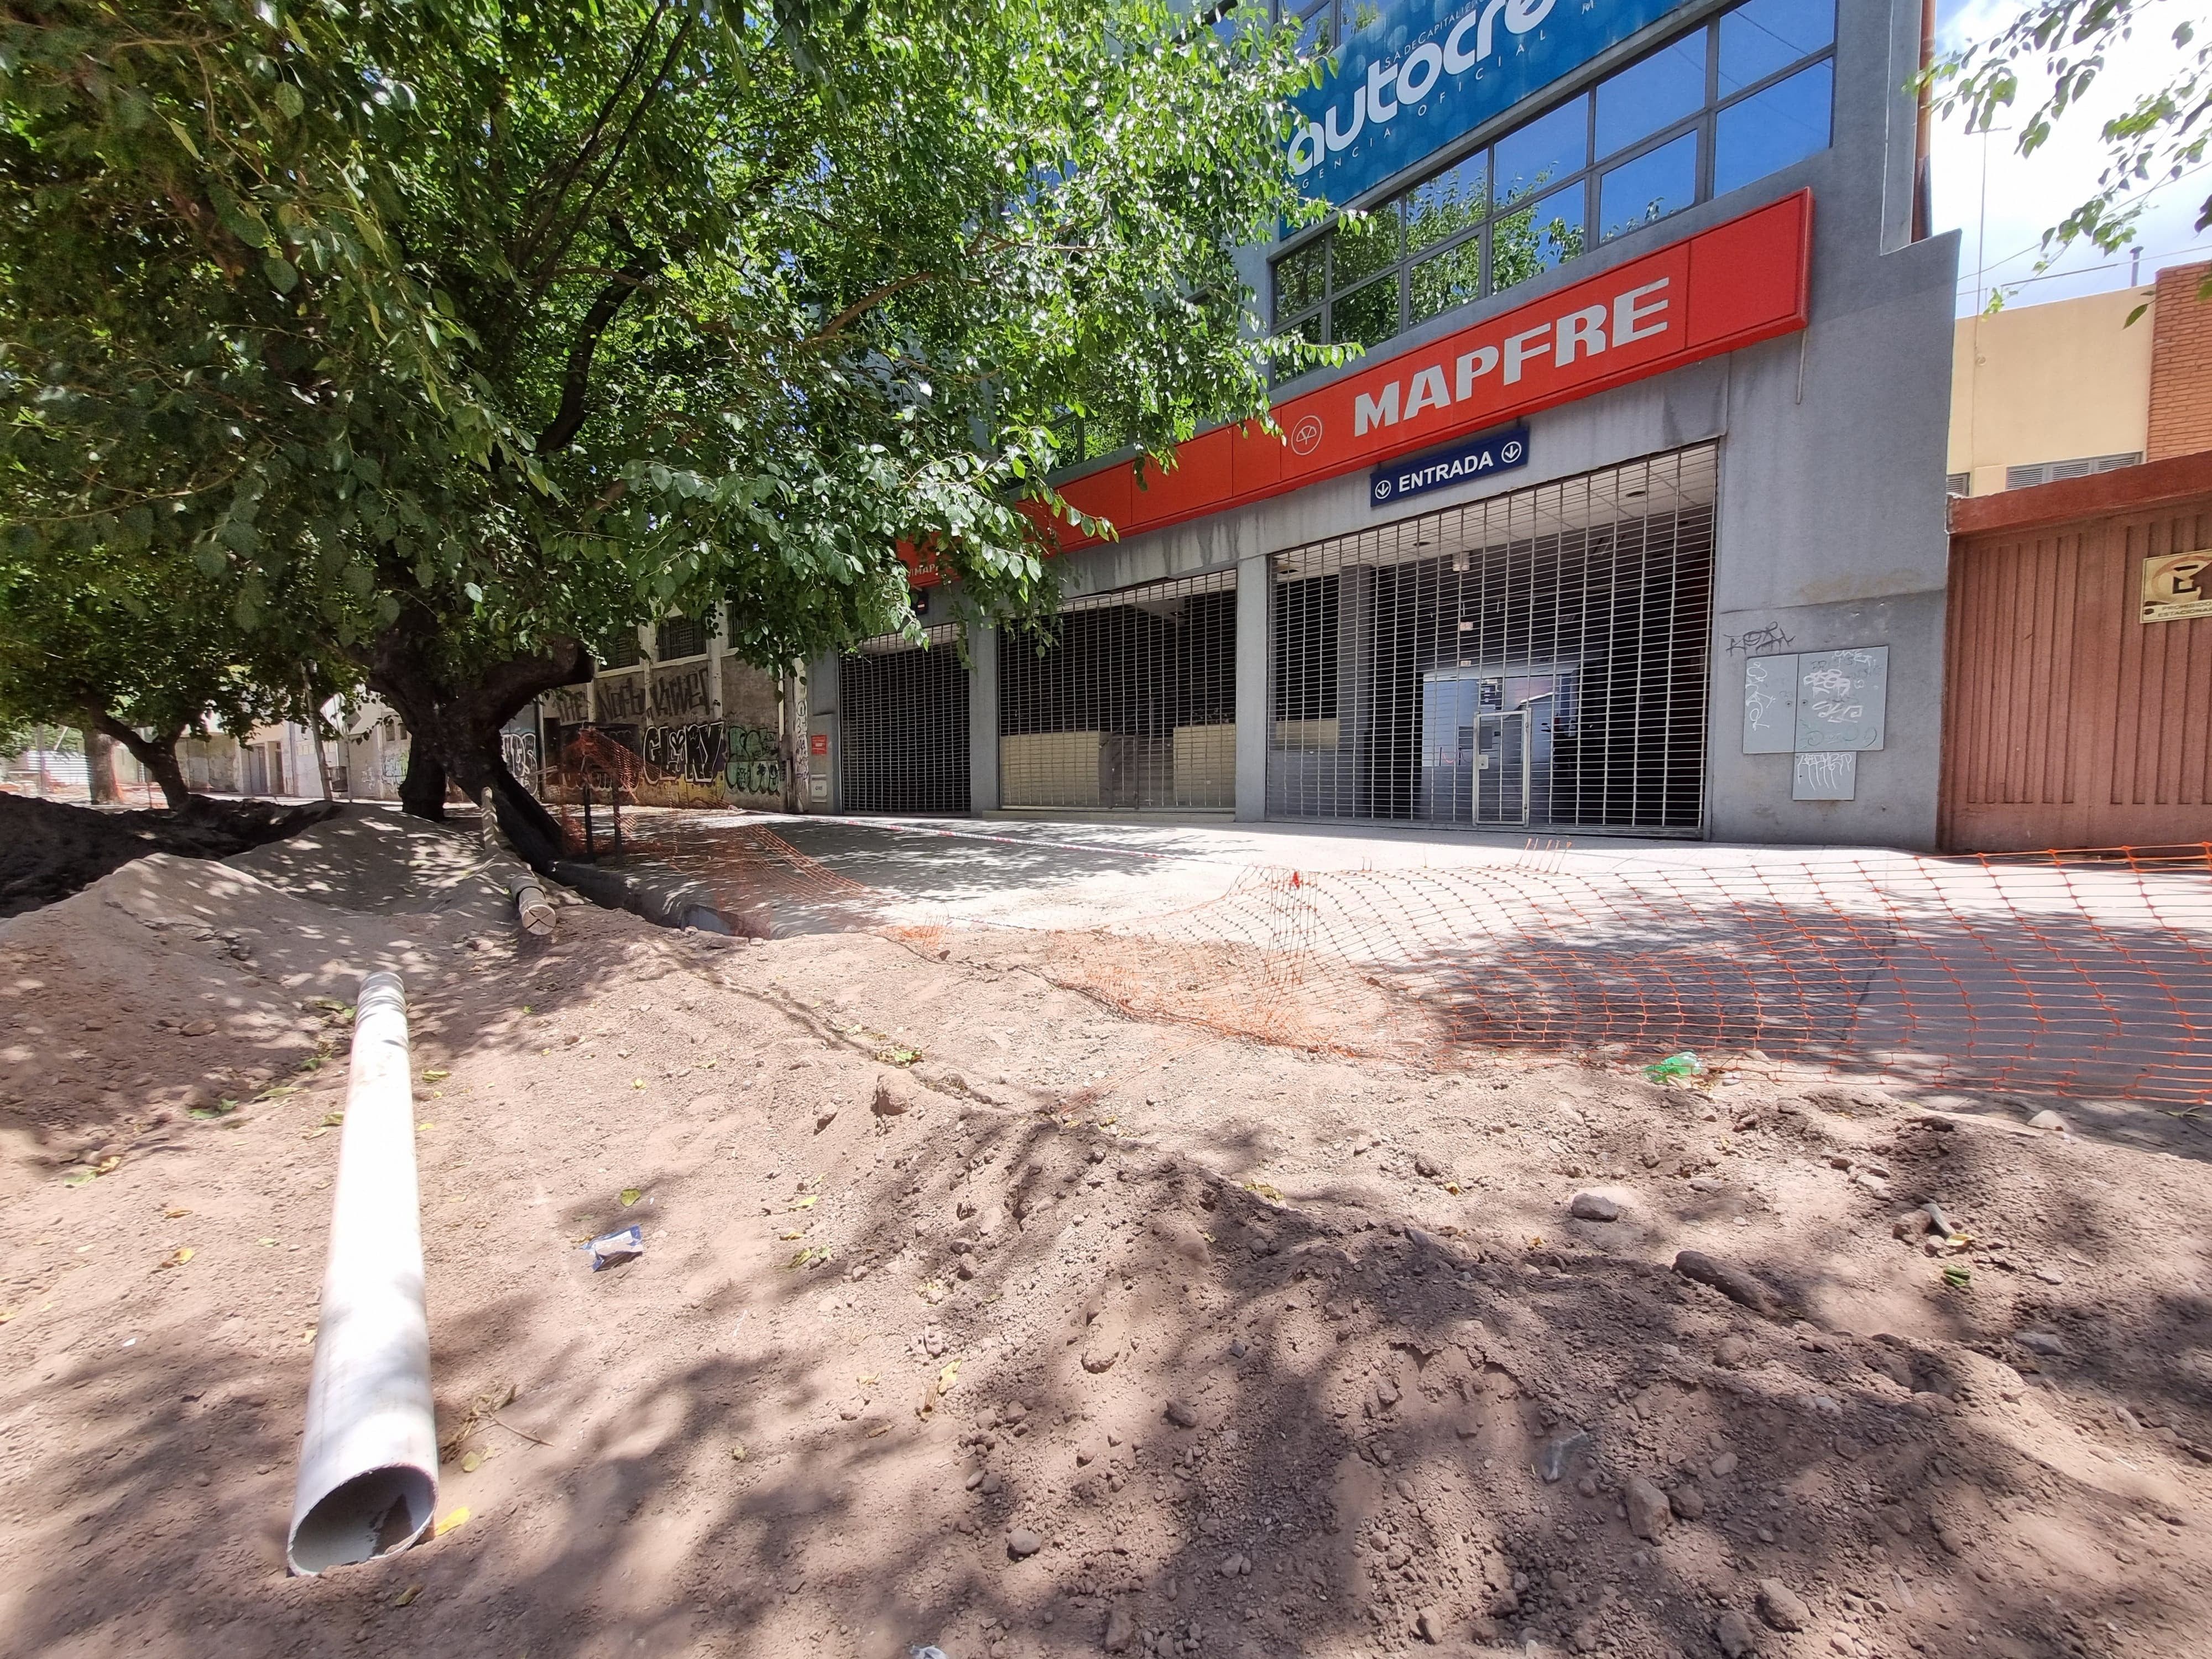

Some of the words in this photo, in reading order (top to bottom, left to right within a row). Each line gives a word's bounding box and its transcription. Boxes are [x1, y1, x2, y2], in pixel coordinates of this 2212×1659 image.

[1298, 128, 1391, 190] GENCIA
[1417, 29, 1546, 116] OFICIAL
[1354, 276, 1670, 437] MAPFRE
[1399, 451, 1493, 493] ENTRADA
